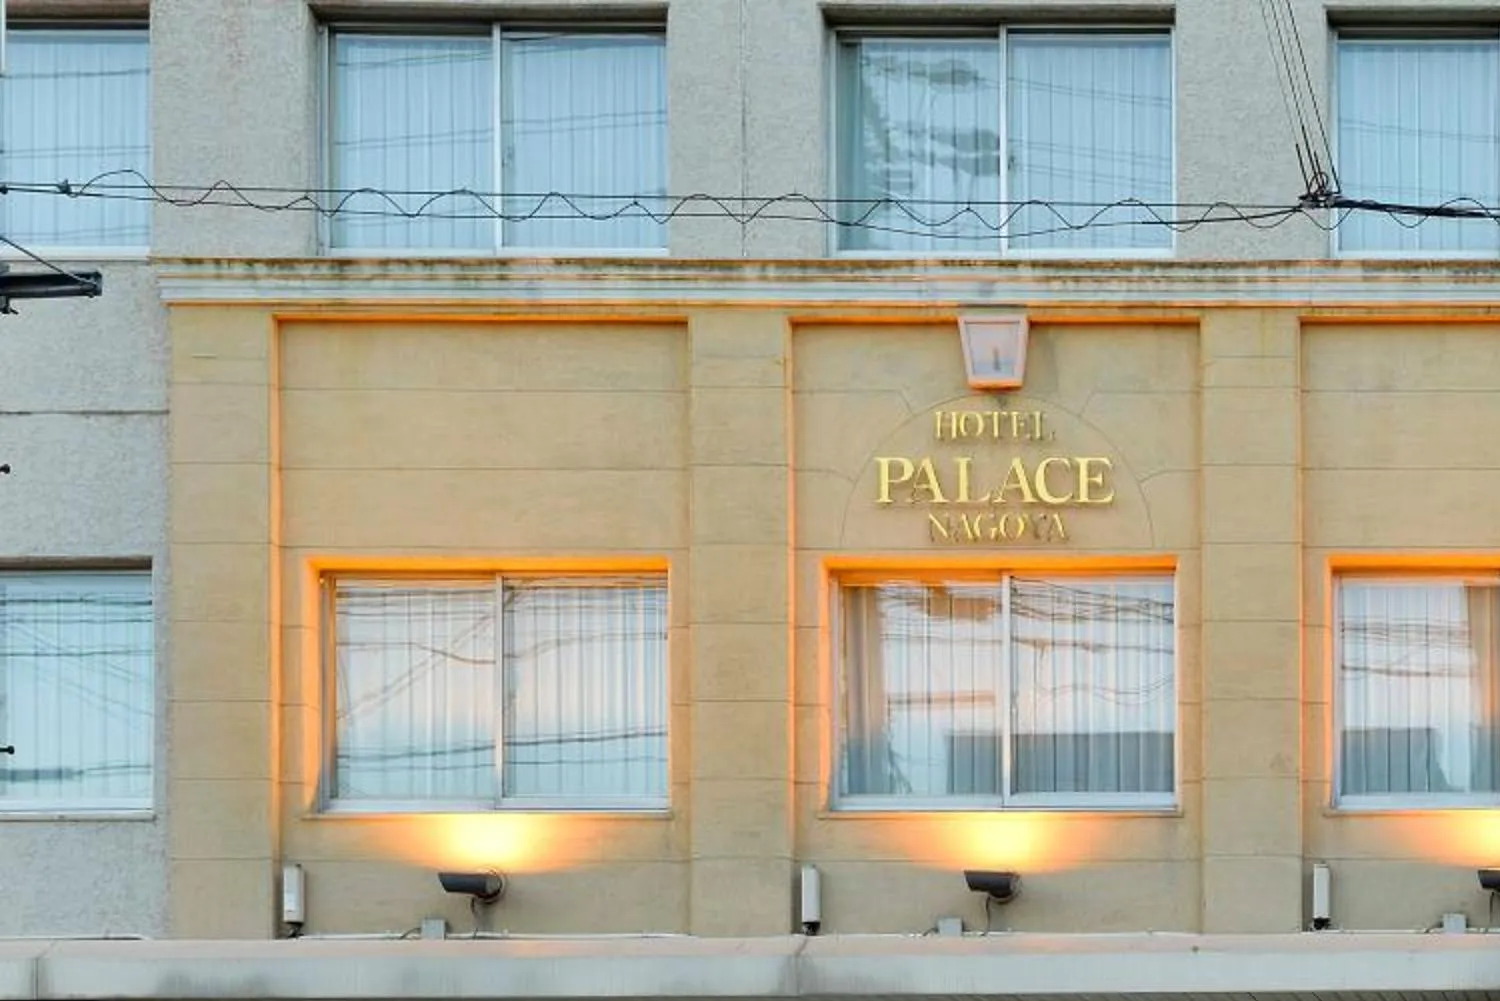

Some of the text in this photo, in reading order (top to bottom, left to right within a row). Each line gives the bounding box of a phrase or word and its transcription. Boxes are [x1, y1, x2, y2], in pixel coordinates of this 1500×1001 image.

[935, 410, 1055, 441] HOTEL
[874, 456, 1116, 505] PALACE
[928, 512, 1070, 542] NAGOYA
